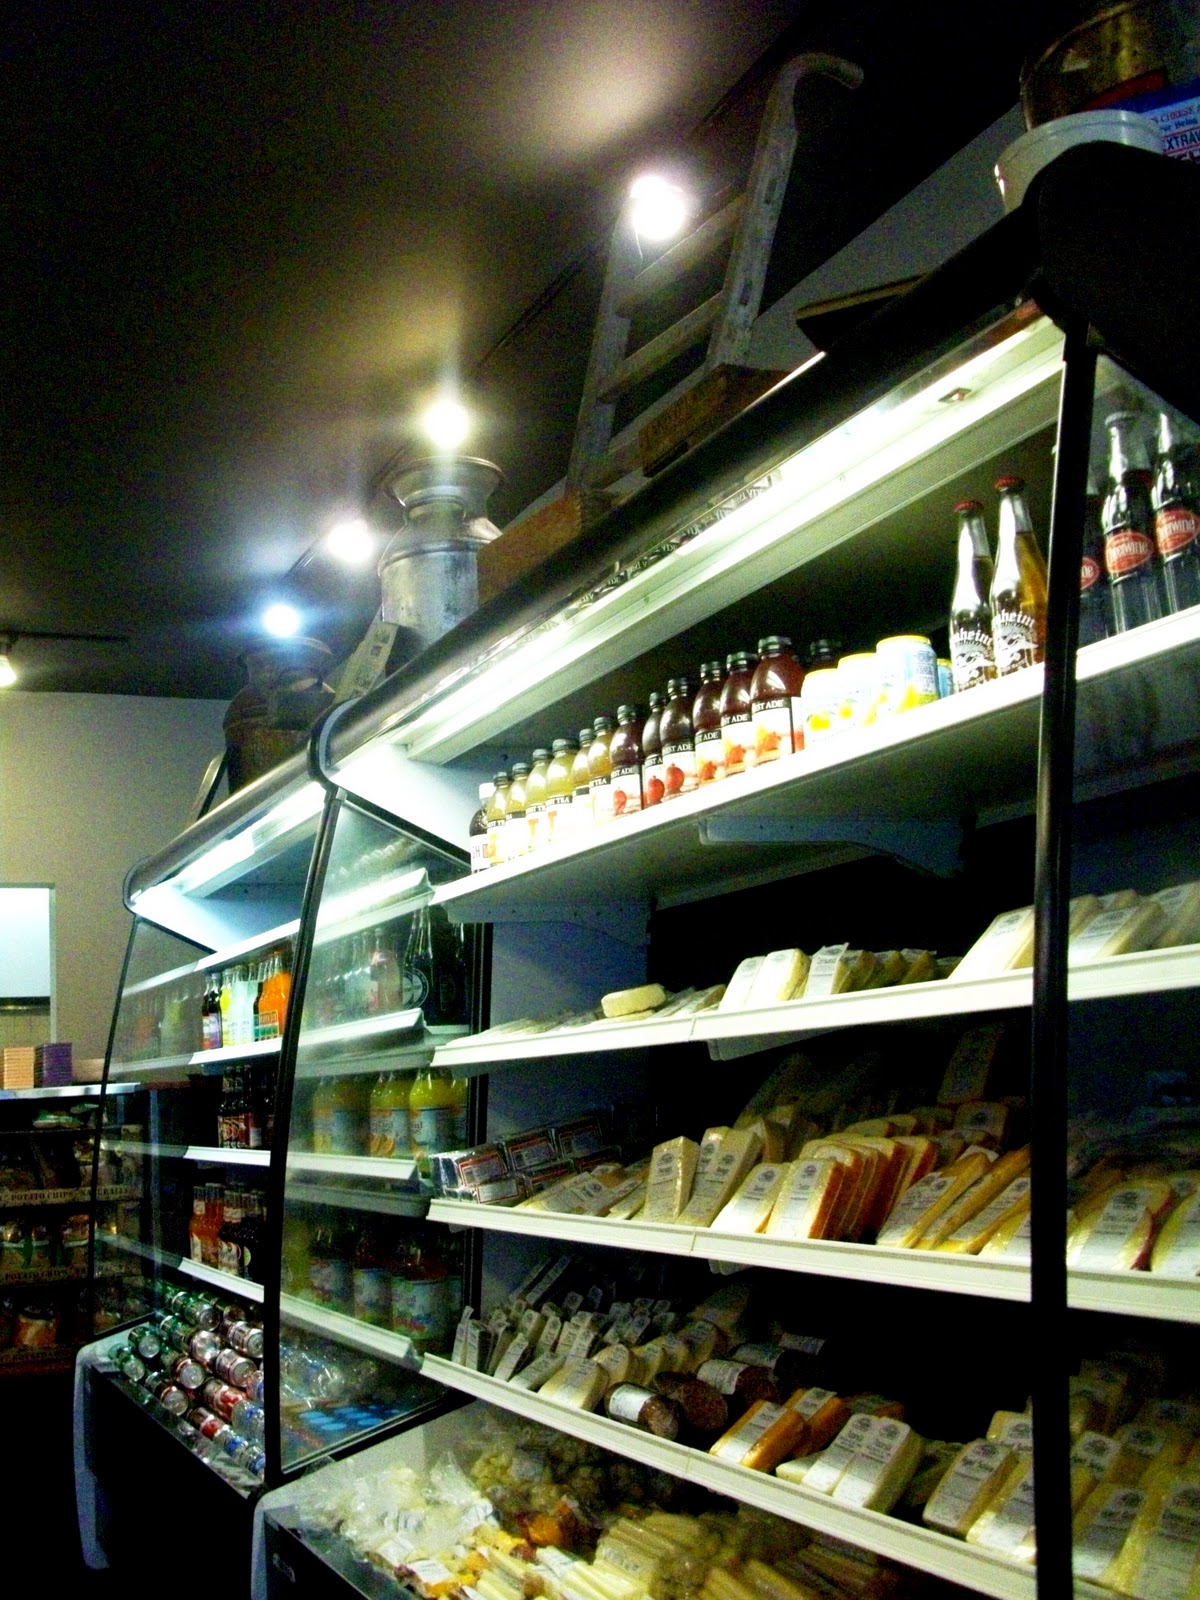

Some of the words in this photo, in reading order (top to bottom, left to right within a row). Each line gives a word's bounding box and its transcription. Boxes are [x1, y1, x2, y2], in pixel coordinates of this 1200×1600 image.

[766, 699, 784, 709] ADE
[731, 713, 748, 723] ADE
[703, 731, 718, 741] ADE
[677, 743, 693, 752] ADE
[80, 1187, 128, 1197] NAURALLY
